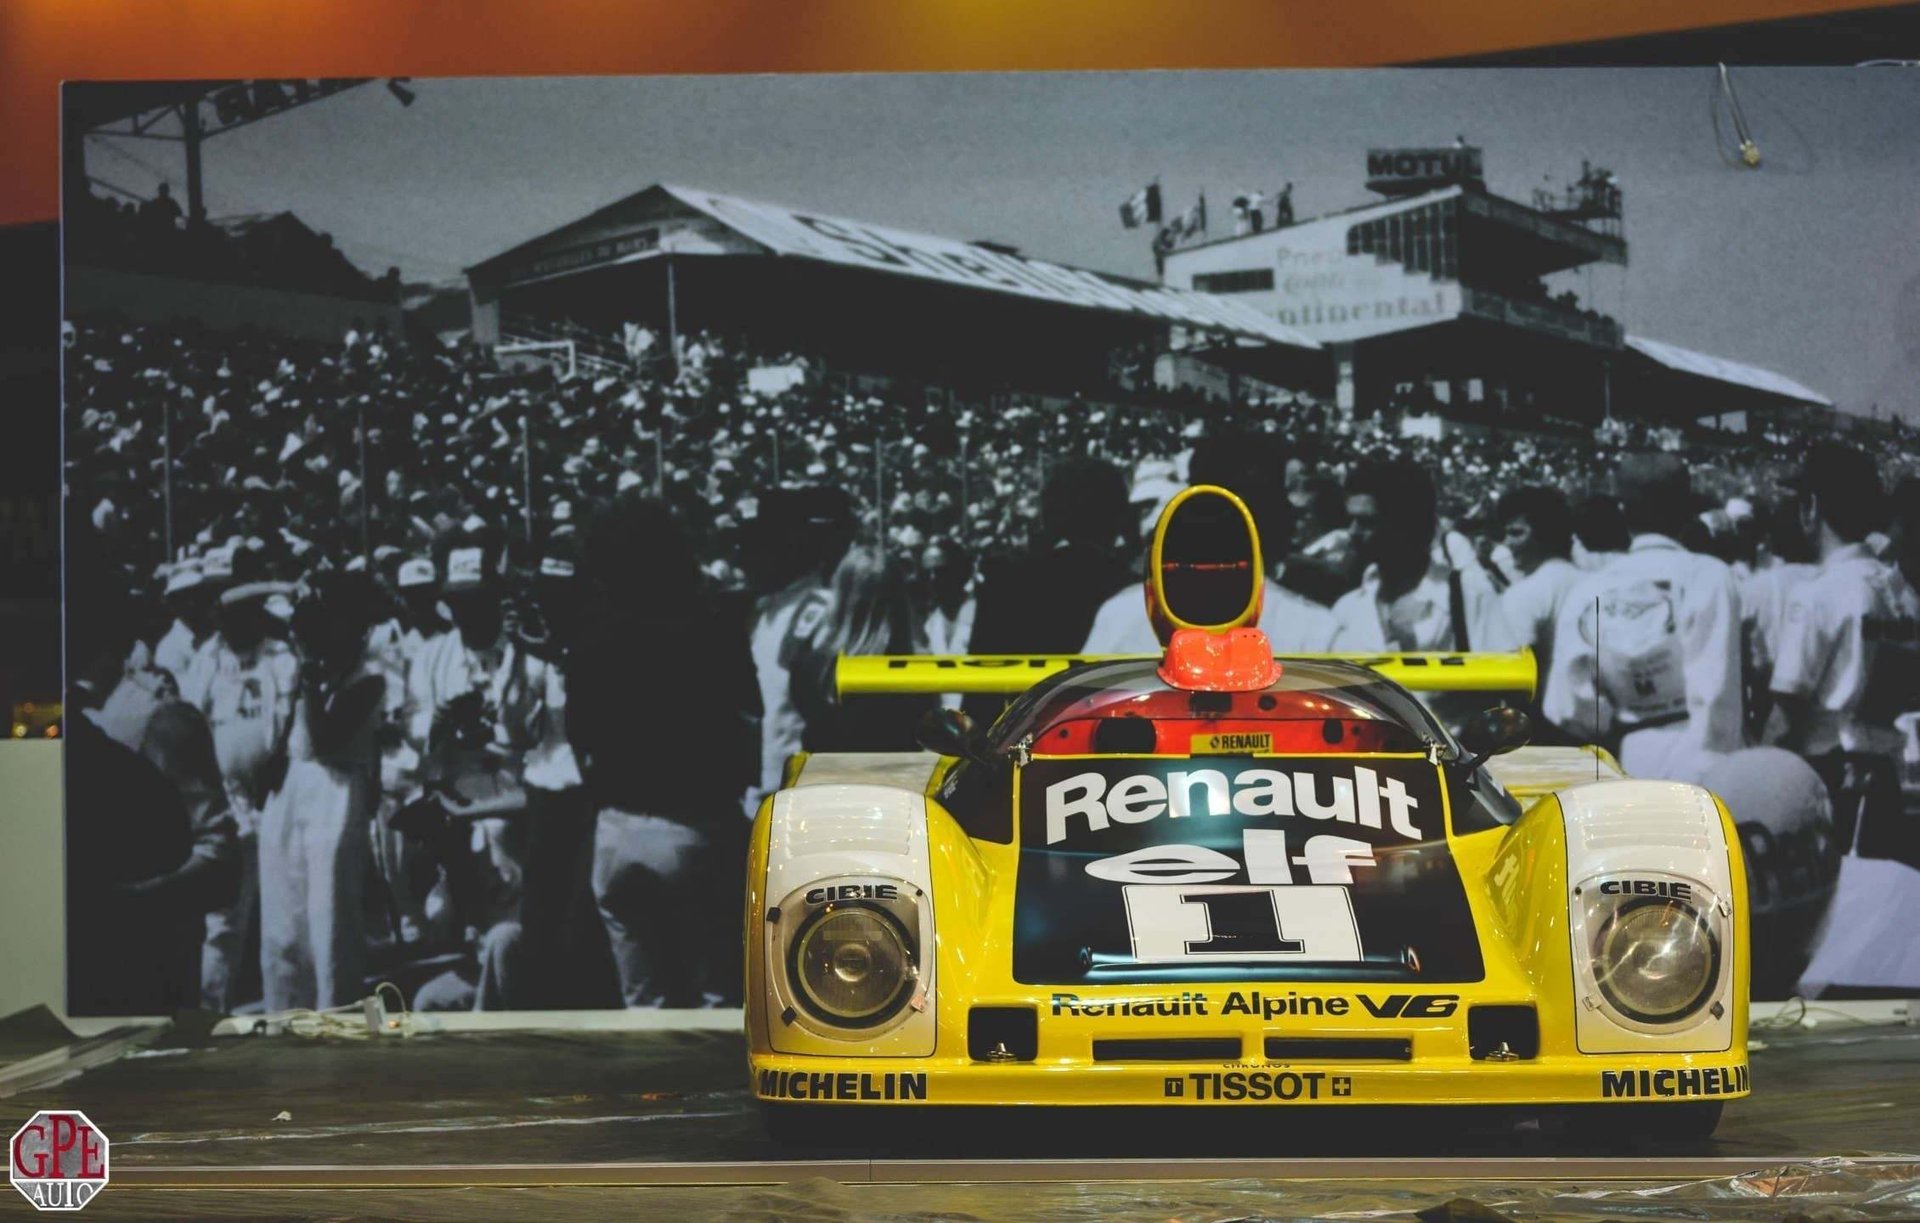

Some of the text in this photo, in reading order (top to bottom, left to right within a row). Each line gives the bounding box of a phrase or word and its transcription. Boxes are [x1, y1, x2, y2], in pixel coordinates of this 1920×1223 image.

[1368, 152, 1482, 177] MOTUL
[1222, 733, 1270, 749] RENAULT
[1046, 765, 1423, 846] Renault
[1084, 828, 1378, 885] elf
[805, 884, 898, 905] CIBIE
[1600, 880, 1692, 901] CIBIE
[1180, 889, 1306, 955] 1
[1052, 991, 1460, 1021] Renault Alpine V6
[760, 1069, 927, 1100] MICHELIN
[1189, 1072, 1326, 1101] TISSOT
[1602, 1064, 1749, 1098] MICHELIN
